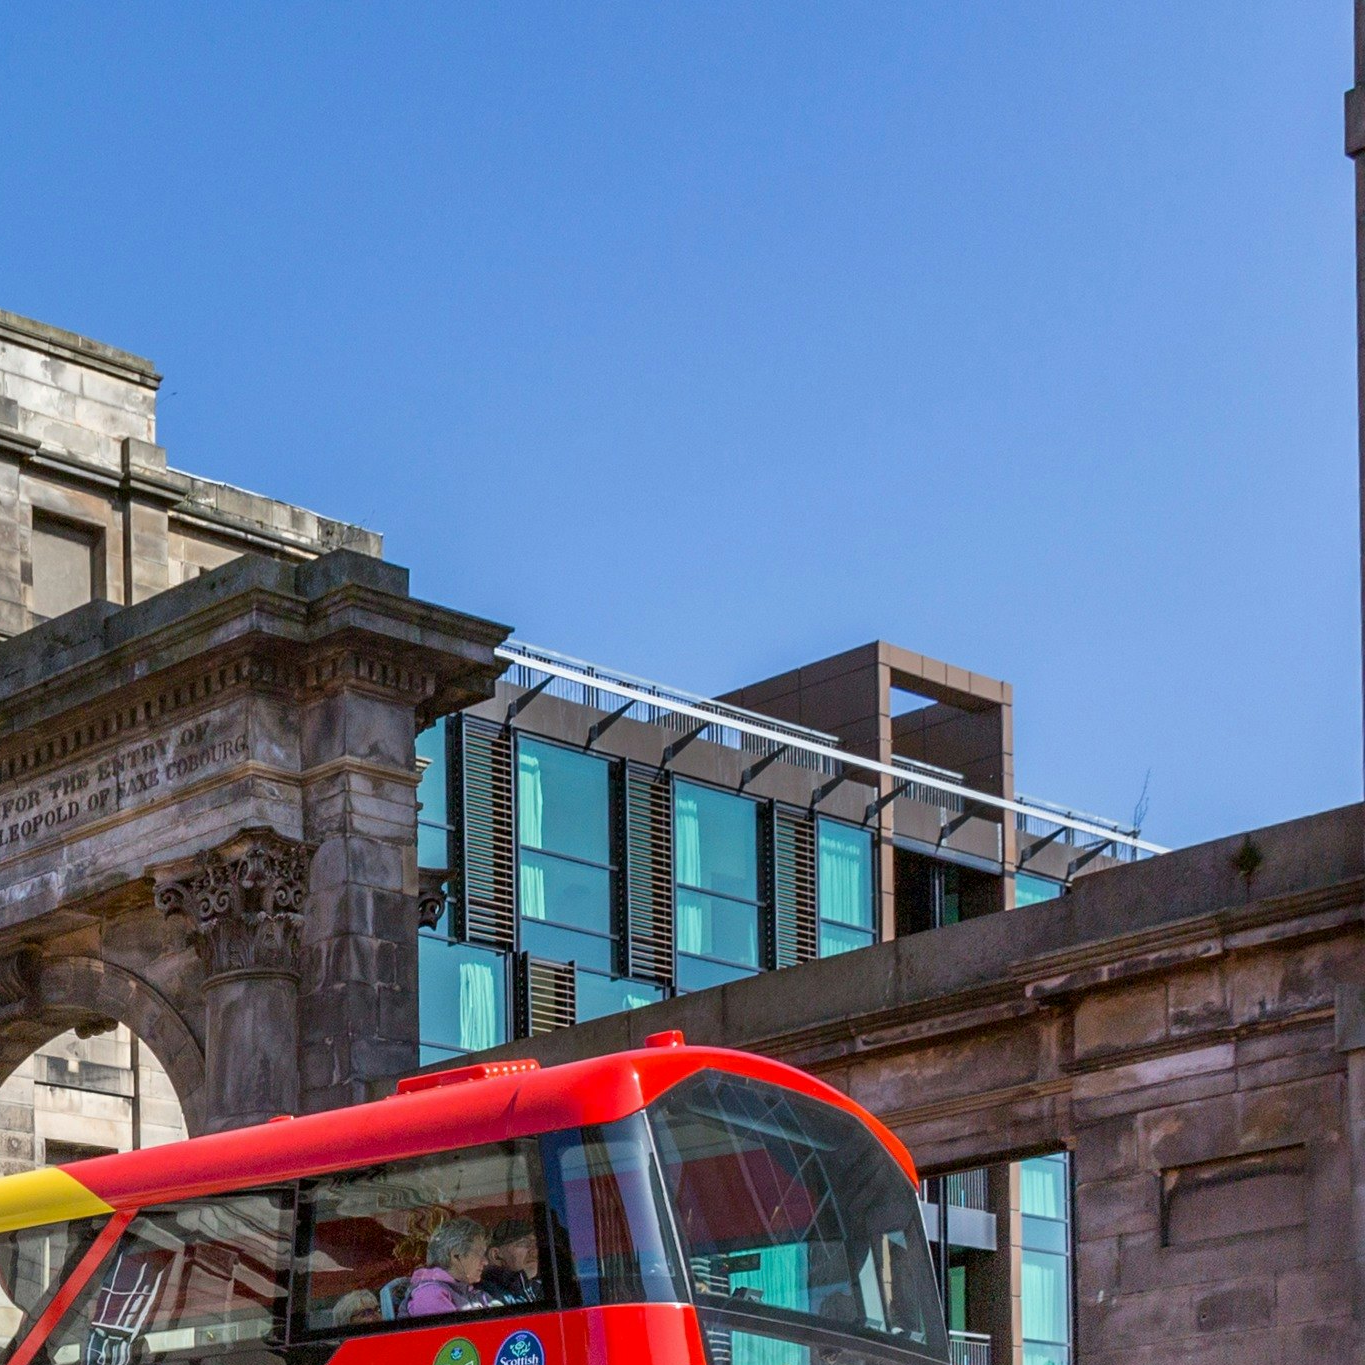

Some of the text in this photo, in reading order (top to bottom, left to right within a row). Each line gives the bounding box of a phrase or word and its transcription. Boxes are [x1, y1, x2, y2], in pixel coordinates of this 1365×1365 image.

[2, 790, 41, 820] FOR
[49, 769, 90, 799] THE
[98, 737, 169, 780] ENTRY
[178, 720, 210, 748] OF
[87, 787, 111, 811] OF
[117, 767, 159, 799] SAXE
